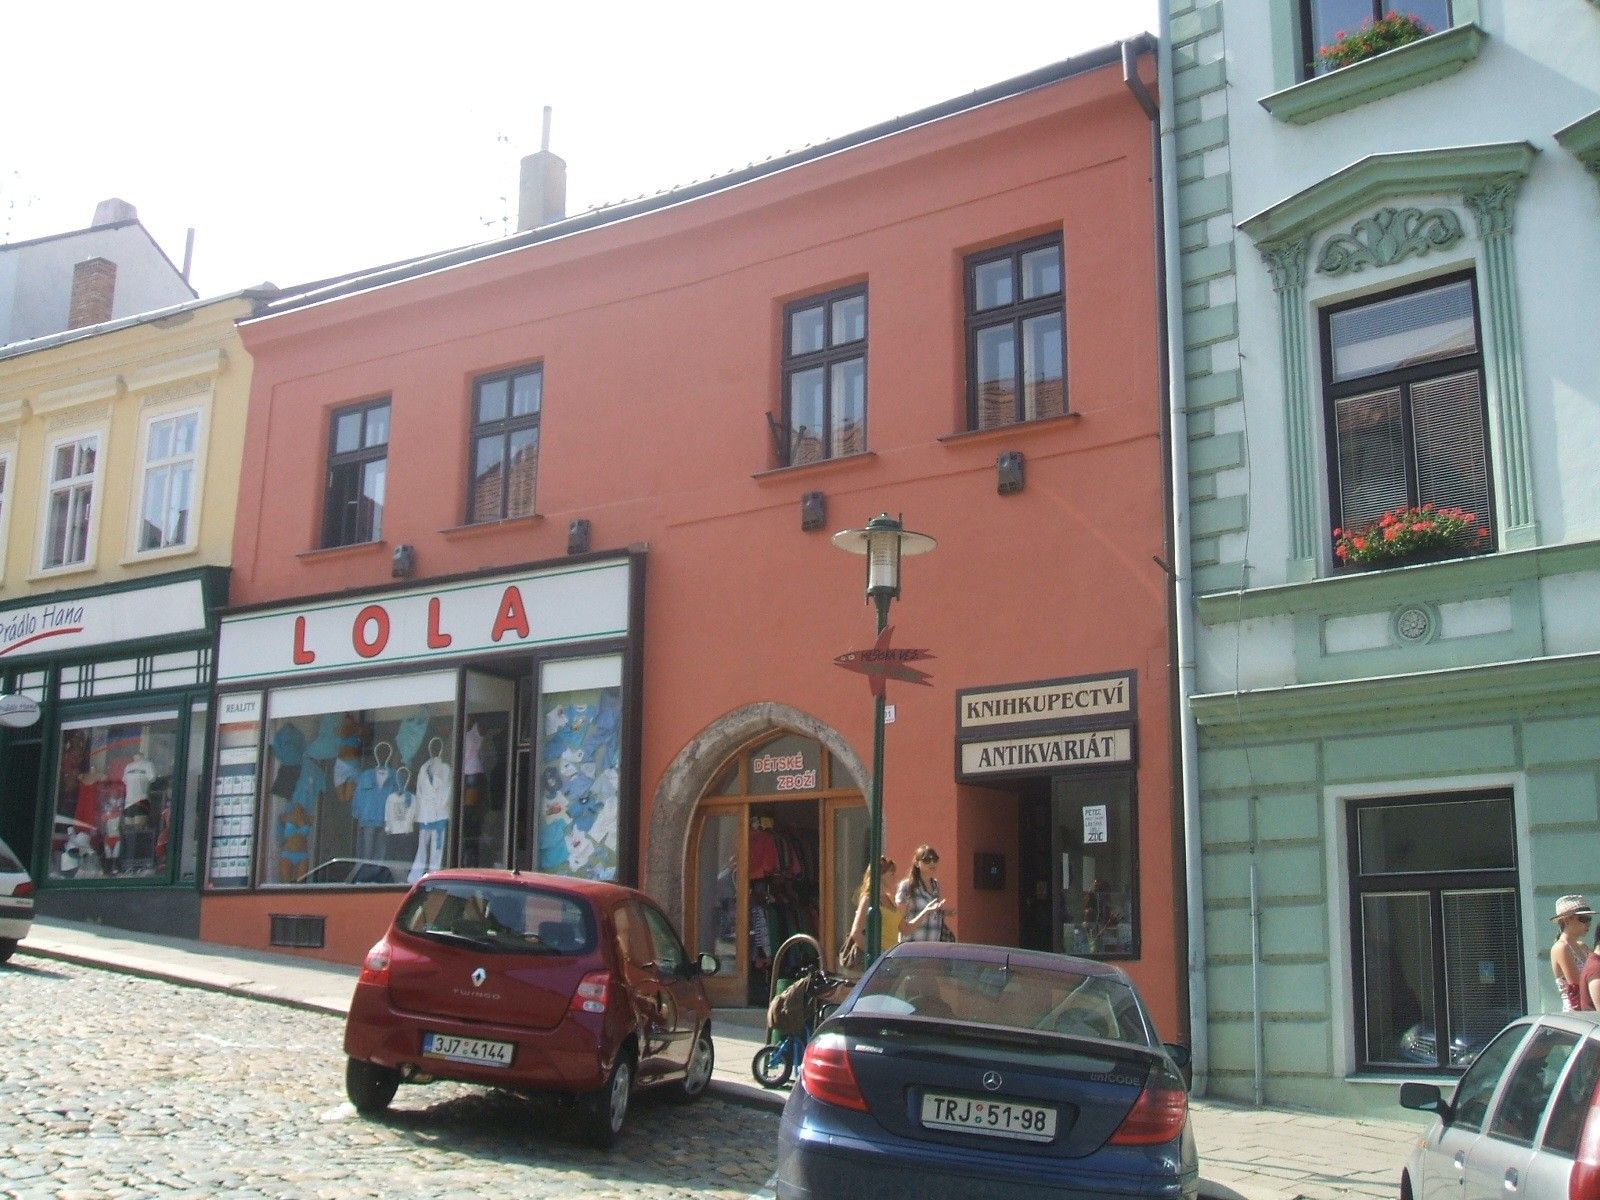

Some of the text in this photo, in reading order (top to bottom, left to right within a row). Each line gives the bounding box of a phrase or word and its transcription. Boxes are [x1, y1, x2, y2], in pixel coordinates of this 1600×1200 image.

[42, 605, 84, 629] Hana
[293, 586, 530, 665] LOLA
[225, 701, 256, 714] REALITY
[967, 681, 1123, 719] KNIHKUPECTVÍ
[754, 752, 803, 772] DĚTSKÉ
[979, 733, 1113, 767] ANTIKVARIÁT
[777, 770, 816, 790] ZBOŽÍ
[436, 1037, 504, 1060] 3J7 4144
[934, 1098, 1046, 1131] TRJ 51-98
